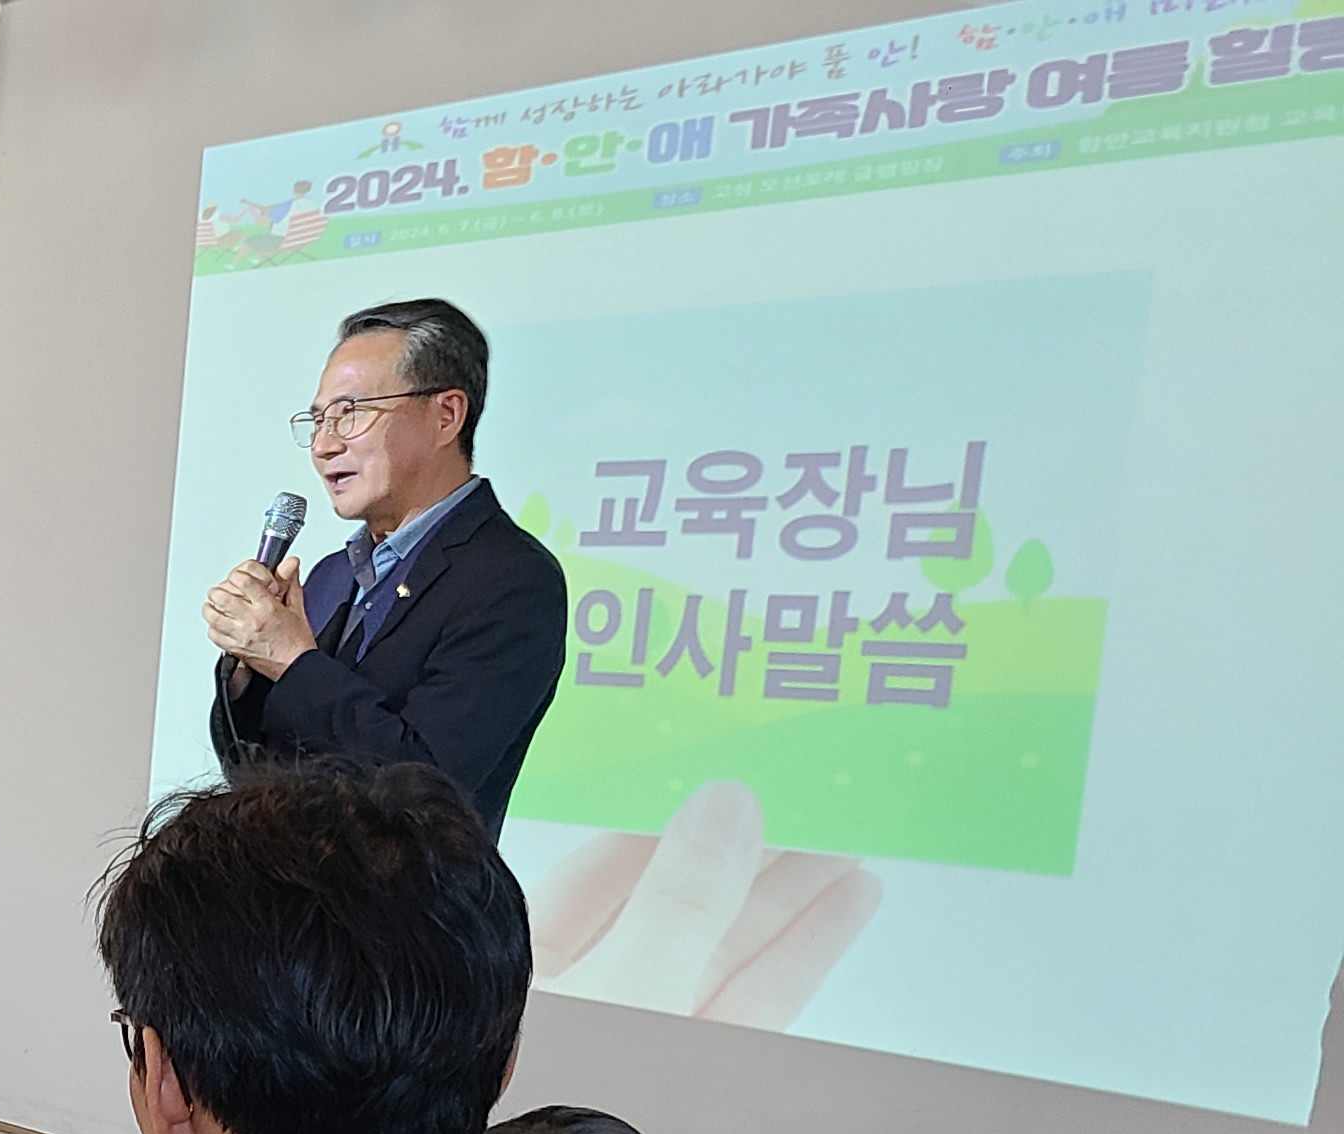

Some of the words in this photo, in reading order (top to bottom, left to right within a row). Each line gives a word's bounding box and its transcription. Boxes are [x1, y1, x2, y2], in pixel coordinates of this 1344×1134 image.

[323, 158, 469, 214] 2024.
[729, 69, 1016, 150] 가족사랑
[1026, 40, 1191, 110] 여름
[439, 111, 507, 139] 함께
[519, 85, 644, 125] 성장하는
[657, 60, 807, 98] 아라가야
[821, 43, 851, 79] 품
[867, 35, 921, 68] 안!
[578, 440, 988, 562] 교육장님
[574, 587, 968, 709] 인사말씀
